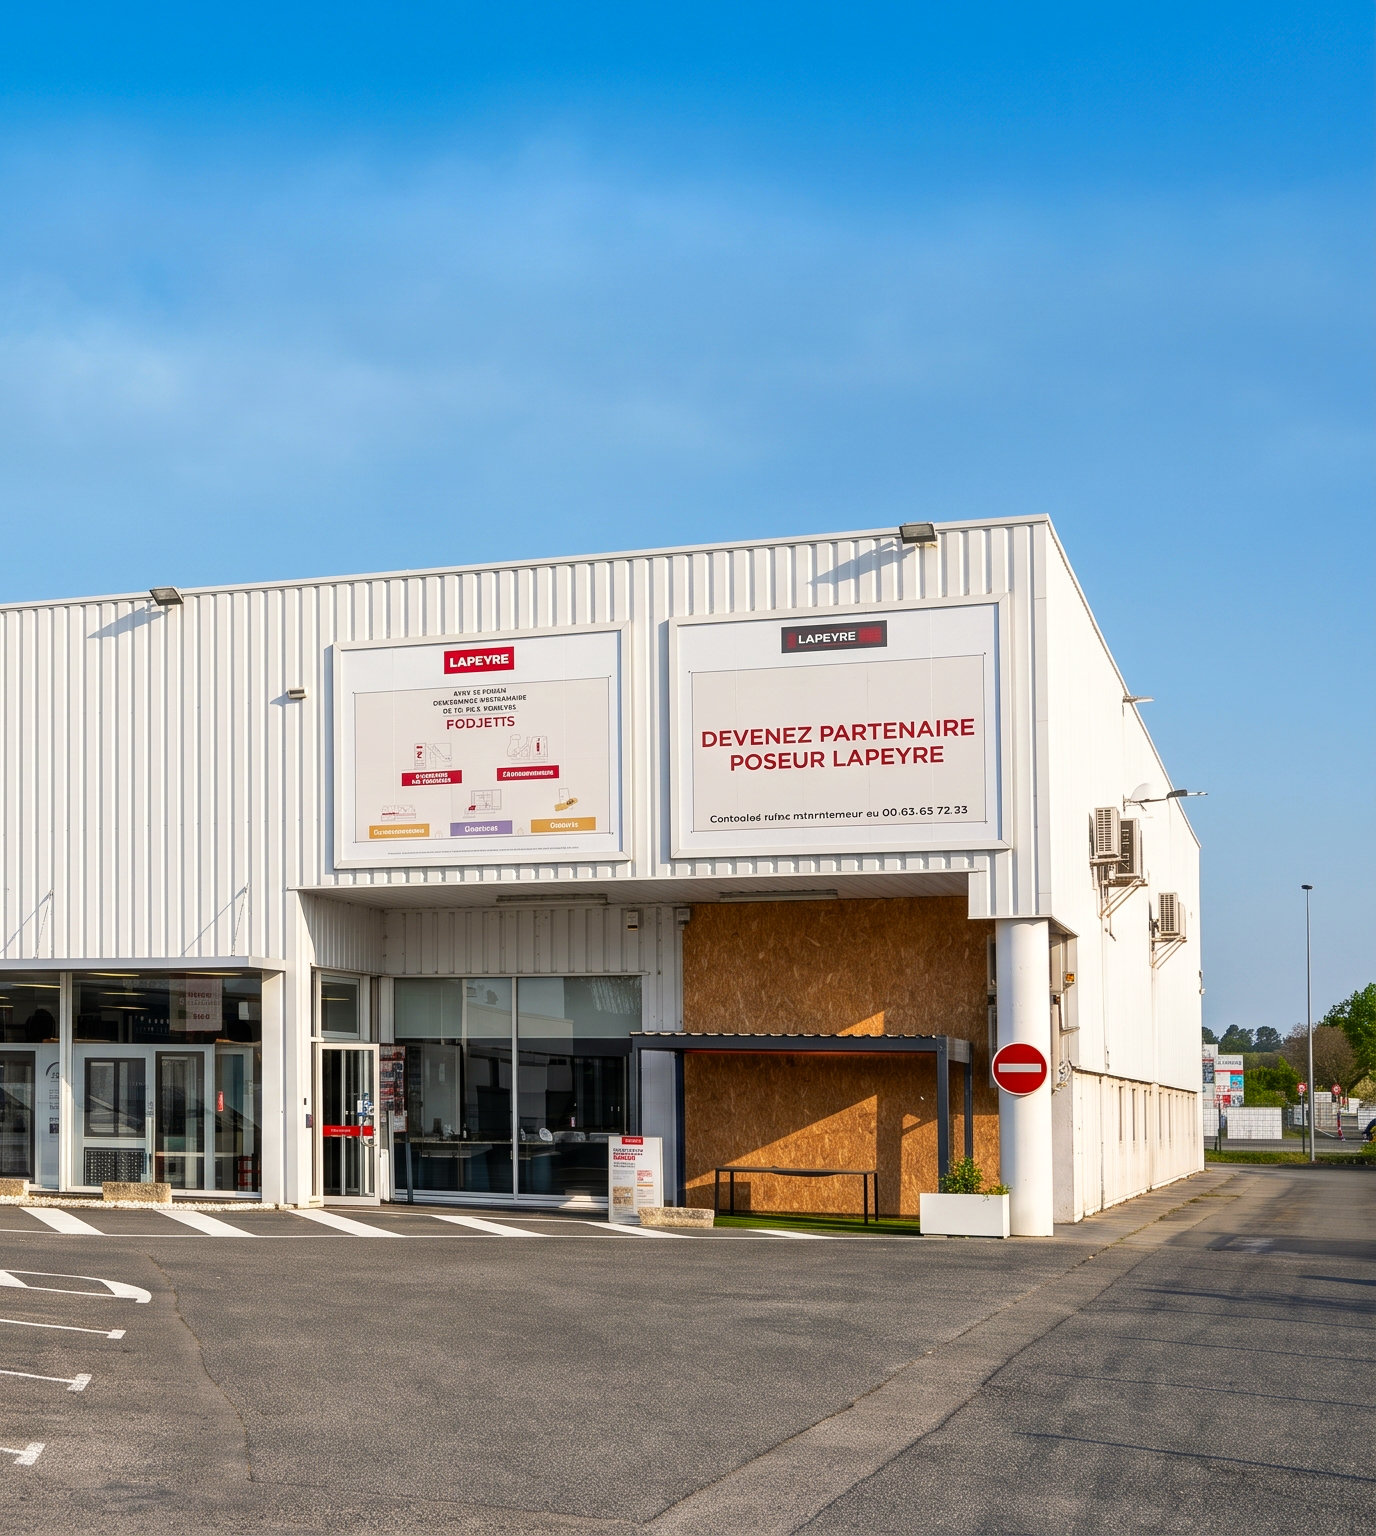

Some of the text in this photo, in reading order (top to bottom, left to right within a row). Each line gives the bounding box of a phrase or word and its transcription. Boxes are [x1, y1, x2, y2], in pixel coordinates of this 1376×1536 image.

[797, 631, 857, 645] LAPEYRE
[449, 654, 509, 668] LAPEYRE
[446, 716, 515, 729] FODJETTS
[701, 718, 975, 748] DEVENEZ PARTENAIRE
[730, 745, 944, 771] POSEUR LAPEYRE
